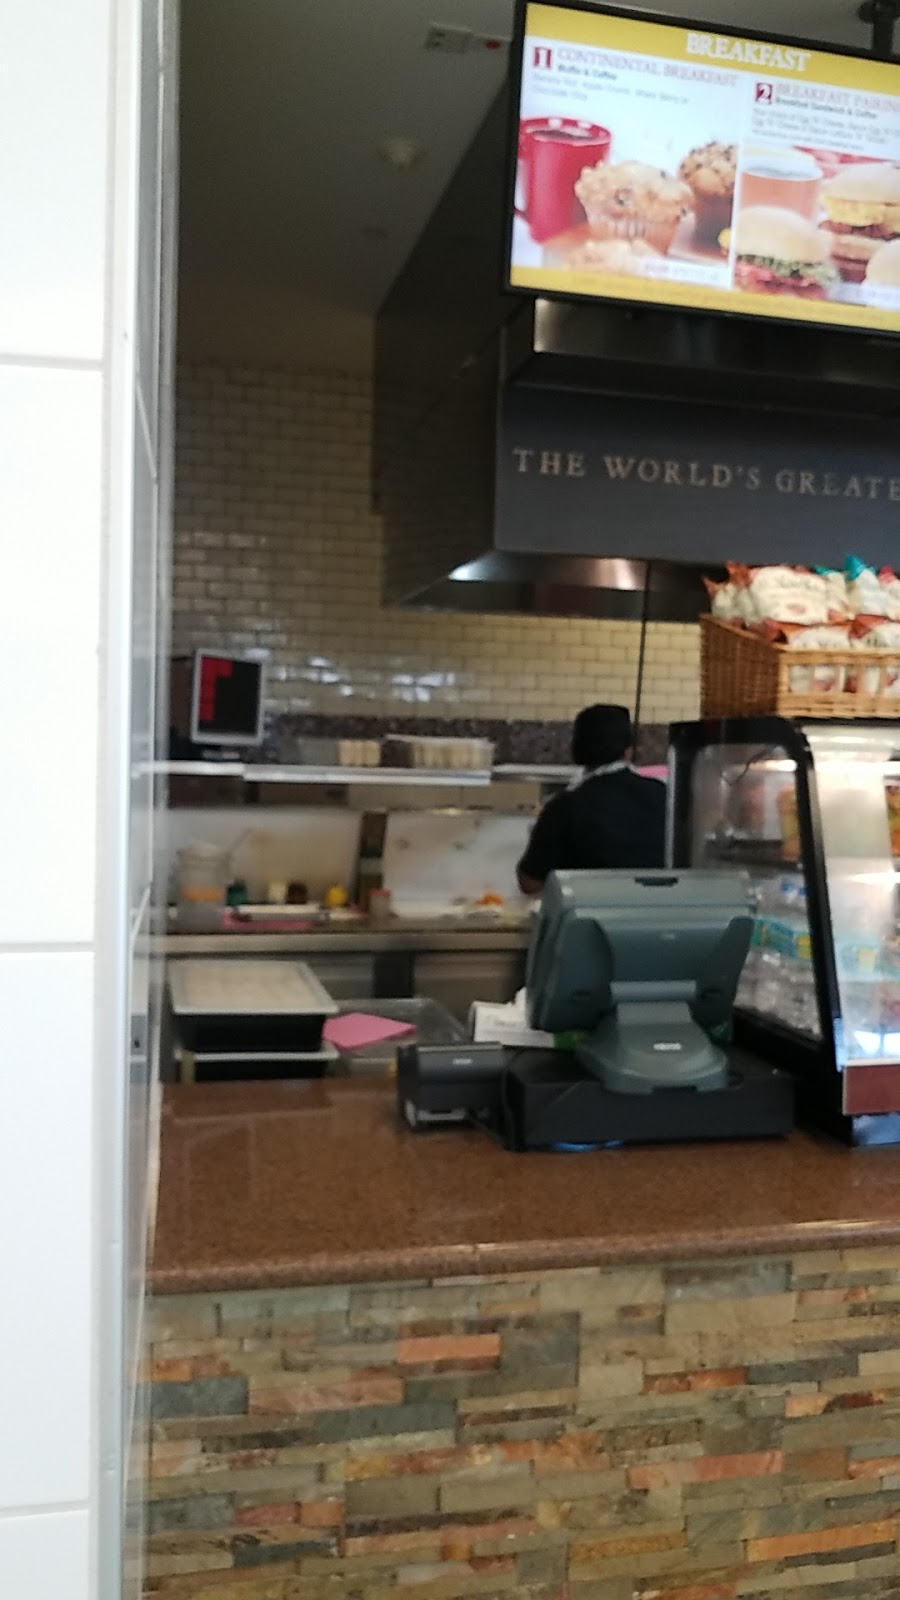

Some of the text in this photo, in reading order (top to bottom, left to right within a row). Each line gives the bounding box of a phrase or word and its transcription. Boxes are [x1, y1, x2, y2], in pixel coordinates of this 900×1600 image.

[557, 47, 661, 76] CONTINENTAL
[663, 63, 737, 88] BREAKFAST
[686, 33, 812, 72] BREAKFAST
[755, 82, 773, 105] 2
[512, 448, 585, 477] THE
[602, 455, 760, 490] WORLD'S
